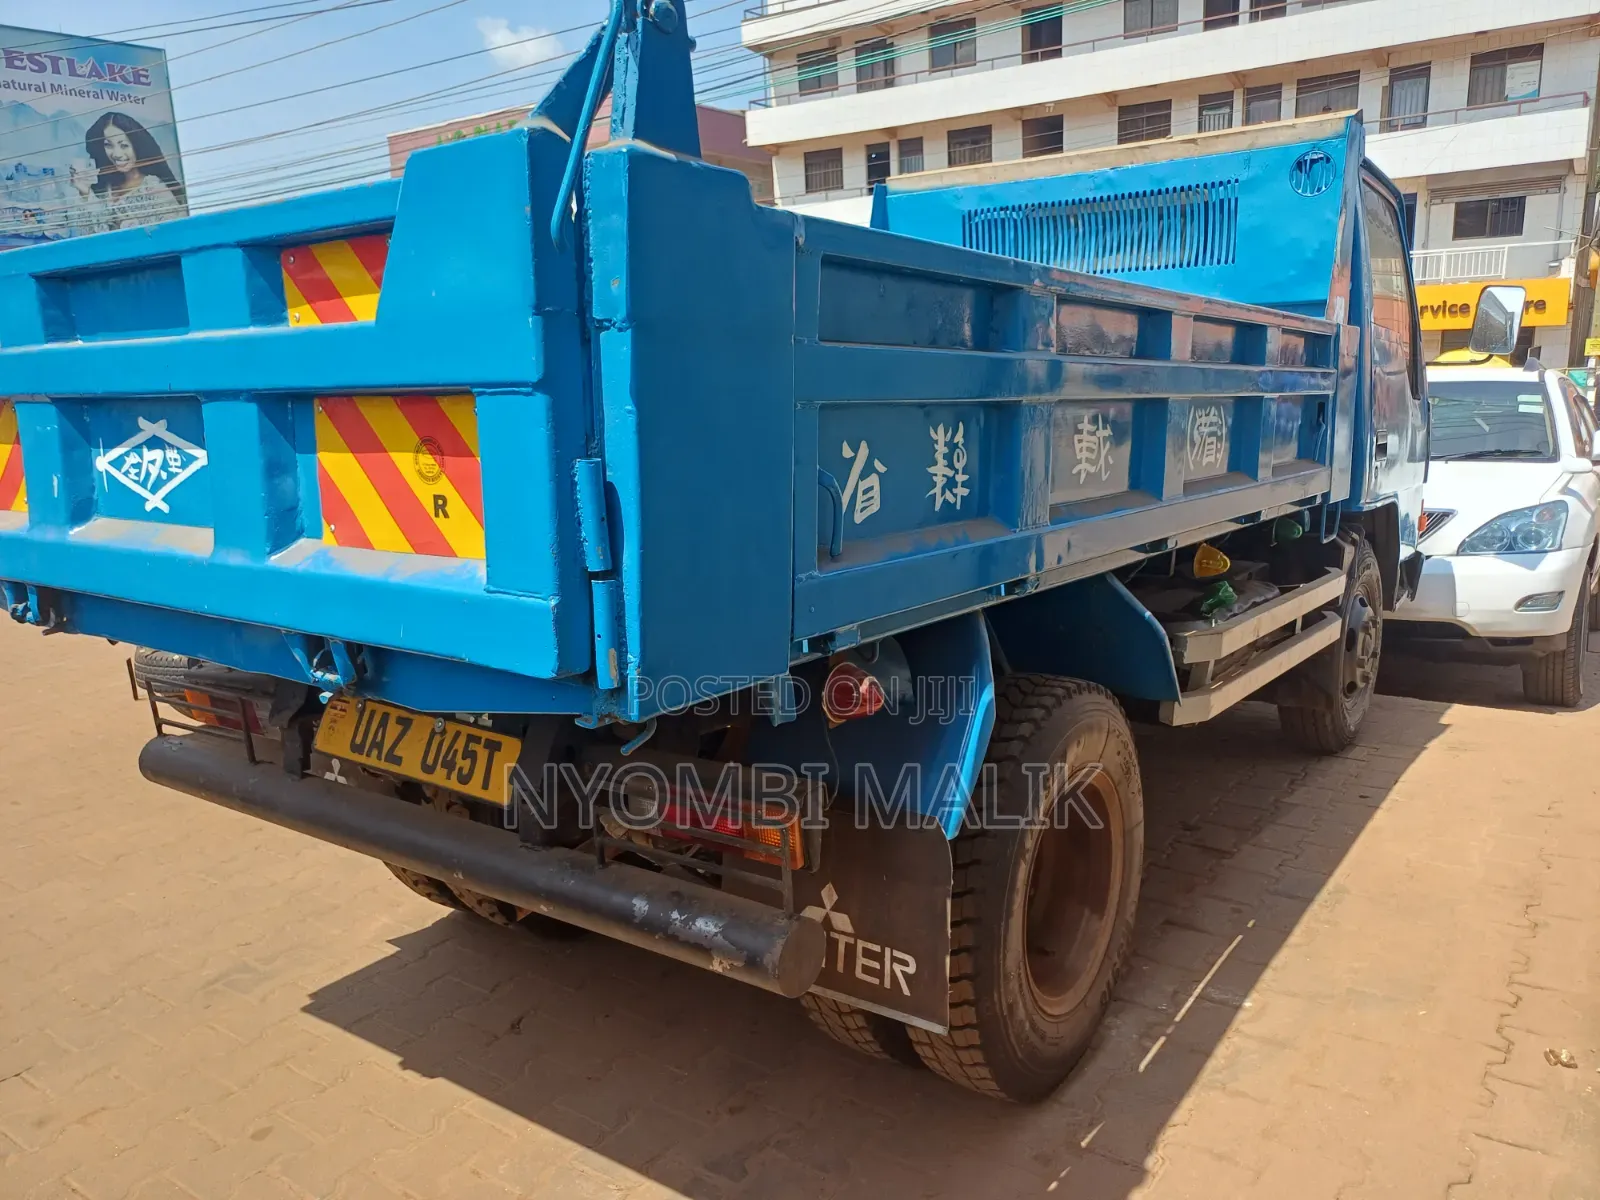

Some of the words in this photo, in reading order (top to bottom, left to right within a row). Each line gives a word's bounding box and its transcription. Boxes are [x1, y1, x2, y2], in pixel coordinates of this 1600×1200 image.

[2, 49, 152, 87] ESTLAKE
[50, 82, 105, 100] Mineral
[107, 90, 146, 105] Water
[1420, 300, 1471, 319] rvice
[432, 493, 450, 519] R
[350, 700, 414, 766] UAZ
[420, 726, 502, 790] 045T
[822, 930, 917, 997] TER
